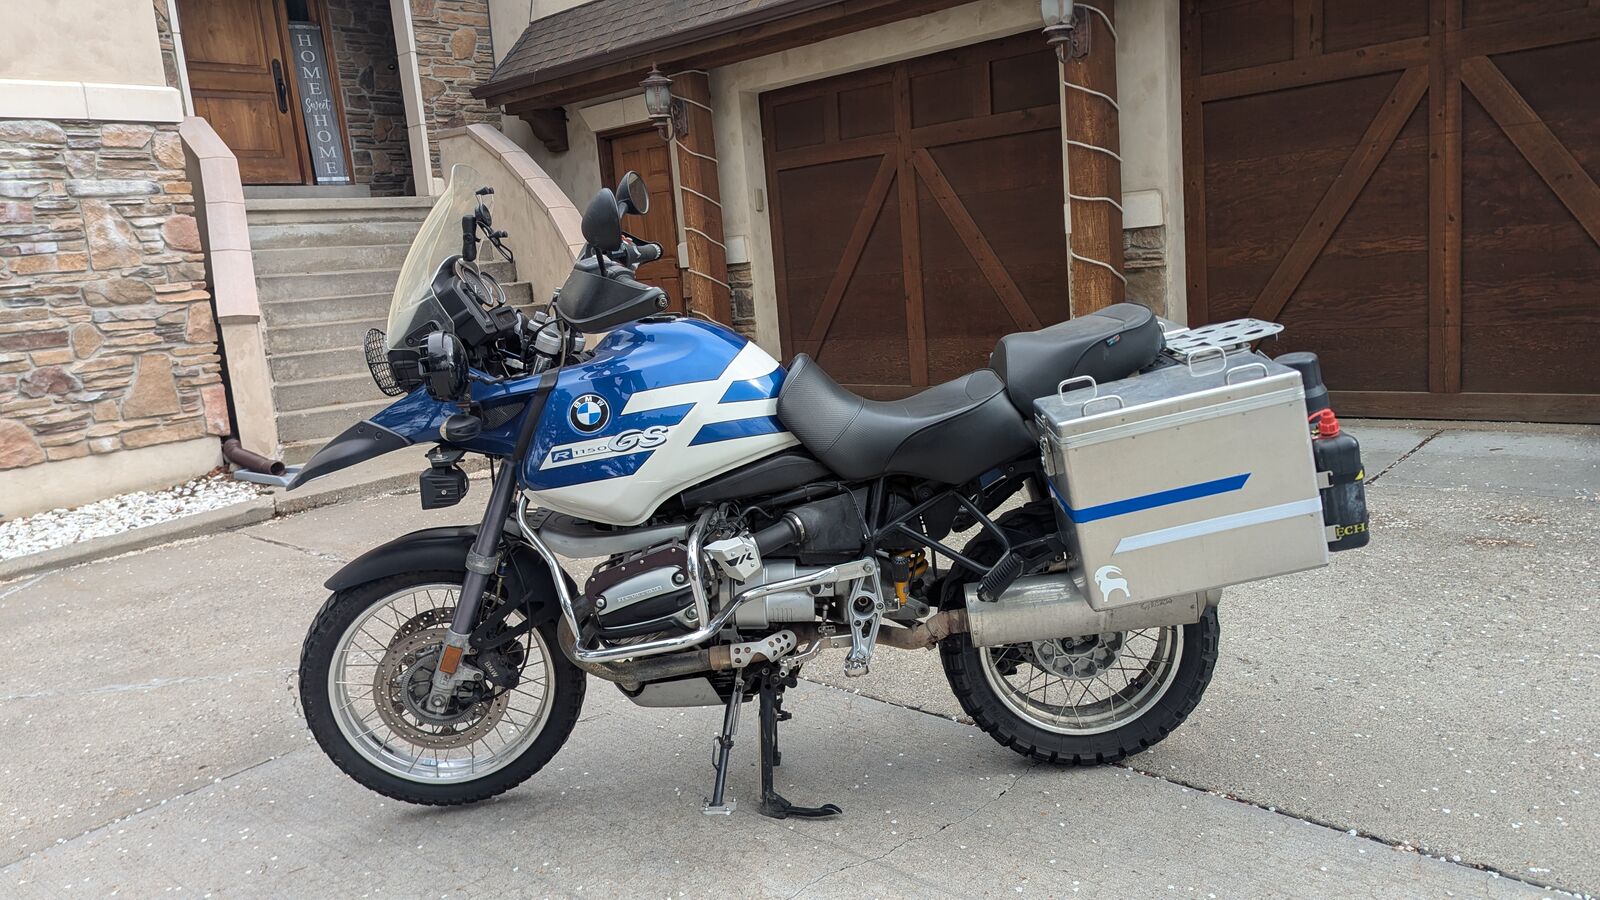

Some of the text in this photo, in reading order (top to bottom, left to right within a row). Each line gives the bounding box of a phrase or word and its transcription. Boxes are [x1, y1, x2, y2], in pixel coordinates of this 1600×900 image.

[297, 34, 322, 95] HOME
[305, 97, 331, 114] Sweet
[313, 114, 338, 174] HOME
[573, 396, 605, 409] BMW
[607, 425, 668, 452] GS
